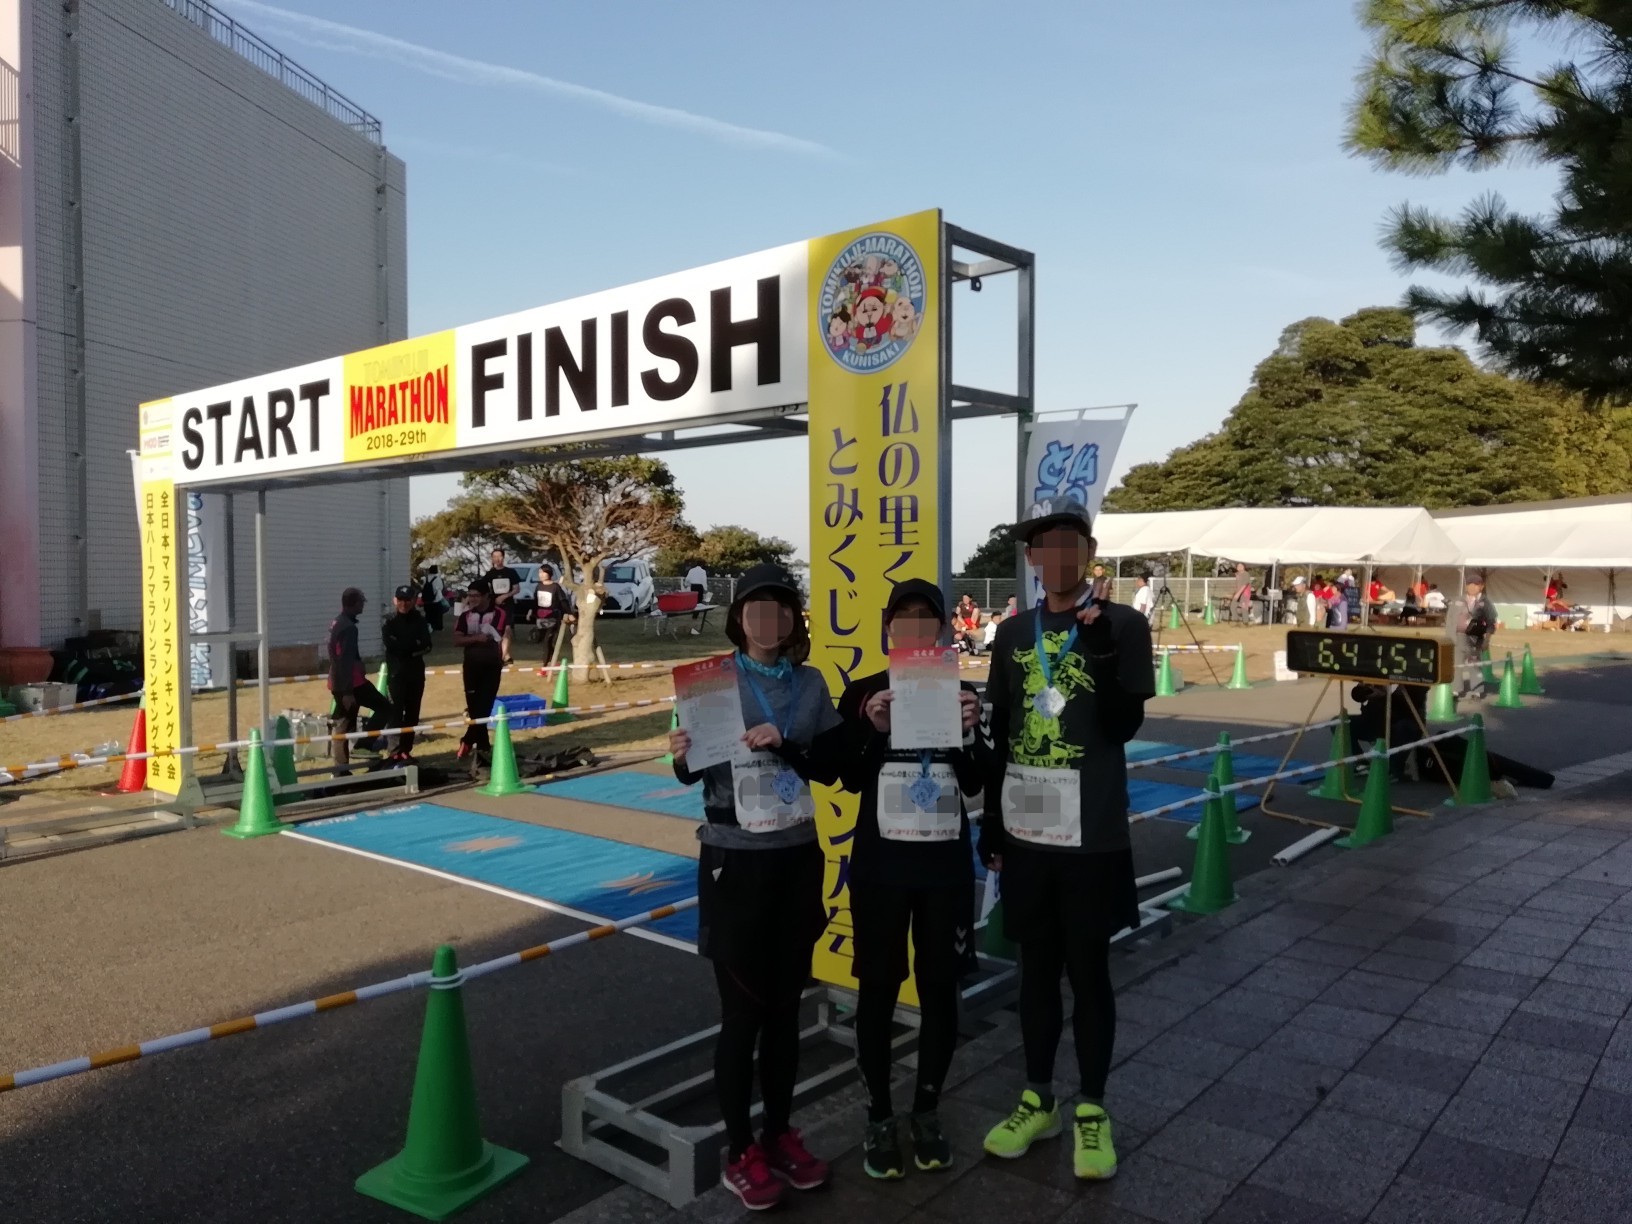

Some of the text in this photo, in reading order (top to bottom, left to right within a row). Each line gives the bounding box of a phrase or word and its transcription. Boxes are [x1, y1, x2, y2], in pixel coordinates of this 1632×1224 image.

[470, 273, 782, 429] FINISH
[842, 342, 900, 368] KUNISAKI
[182, 378, 331, 472] START
[349, 363, 449, 439] MARATHON
[366, 428, 427, 451] 2018-29th
[146, 492, 160, 777] 日本ハーフマラソンランキング大会
[160, 490, 176, 780] 全日本マラソンランキング大会
